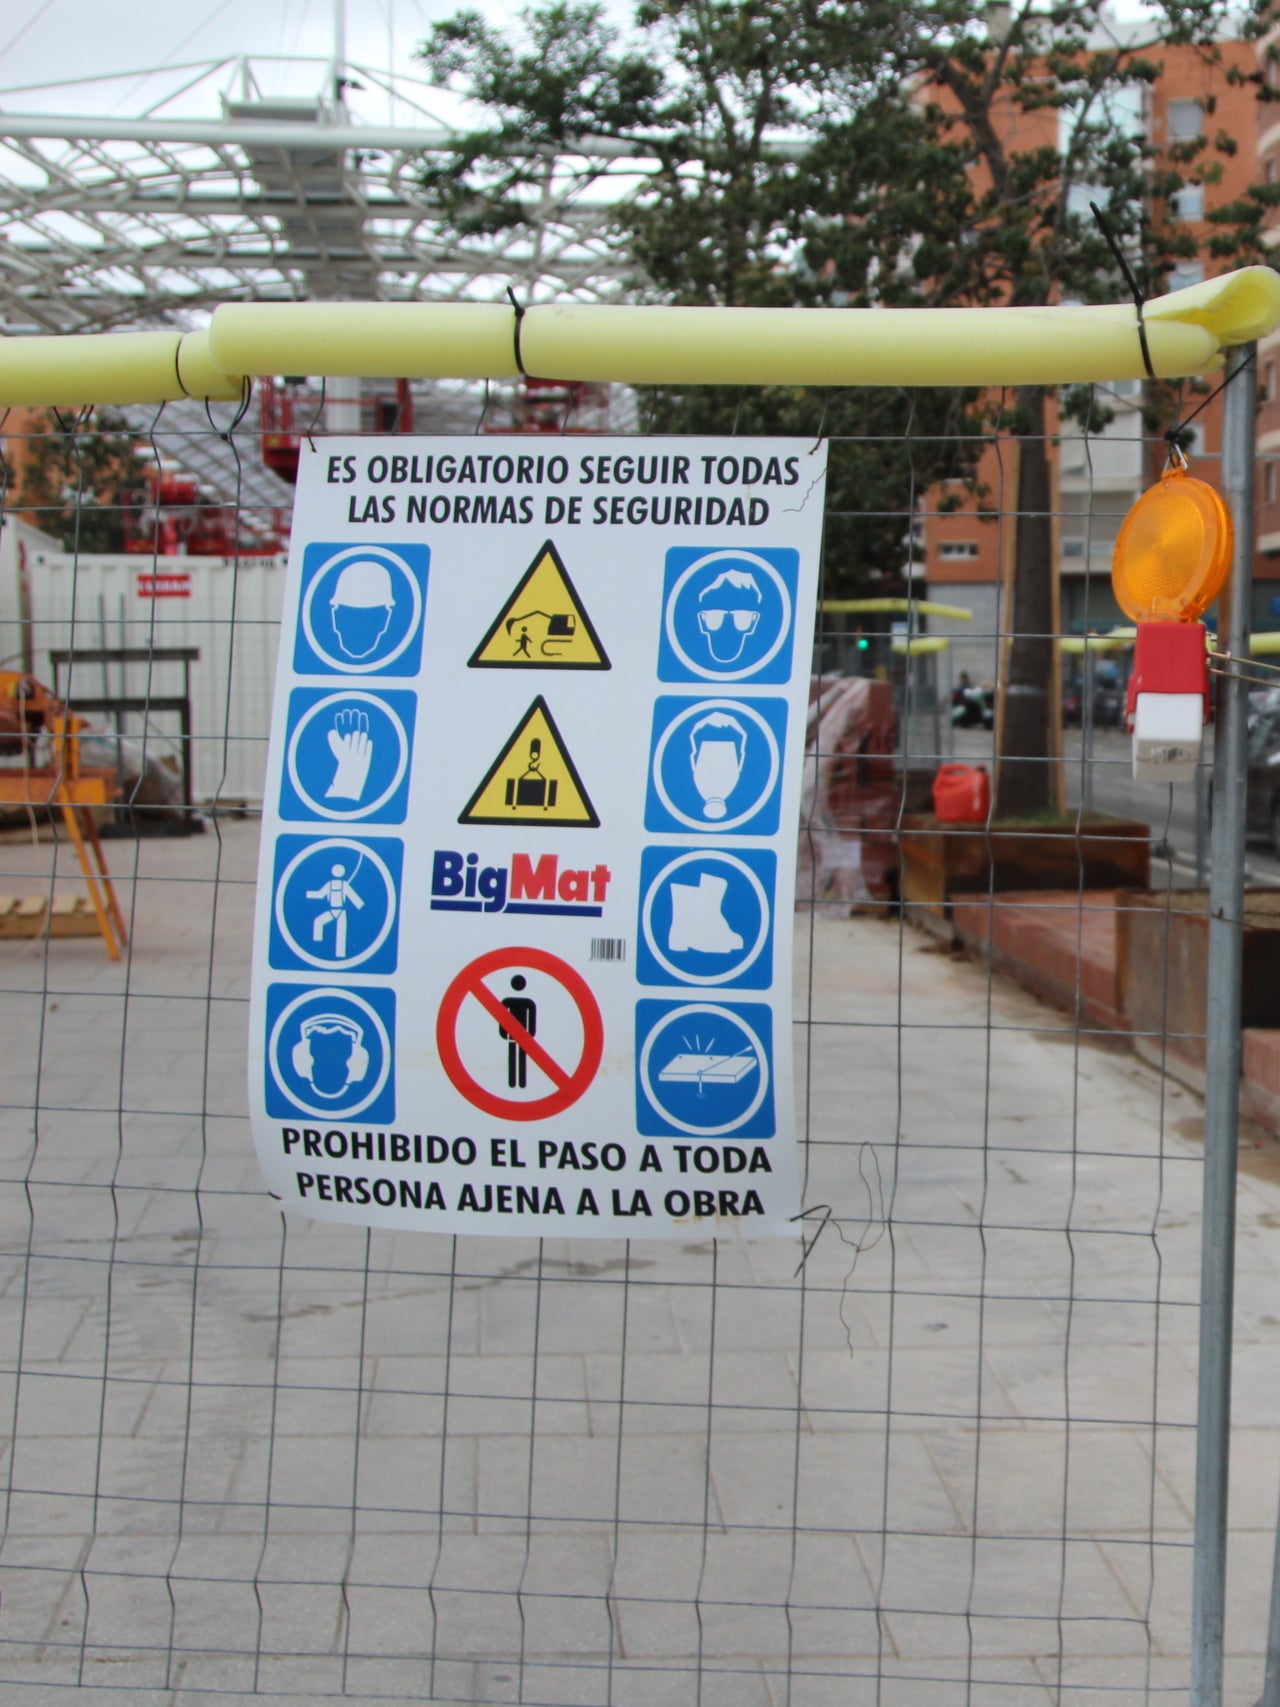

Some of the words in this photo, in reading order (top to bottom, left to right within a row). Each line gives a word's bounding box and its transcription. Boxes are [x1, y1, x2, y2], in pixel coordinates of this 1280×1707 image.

[328, 456, 356, 483] ES
[368, 456, 568, 483] OBLIGATORIO
[580, 456, 689, 483] SEGUIR
[702, 456, 798, 485] TODAS
[349, 495, 395, 523] LAS
[407, 496, 533, 523] NORMAS
[545, 497, 582, 524] DE
[593, 497, 769, 525] SEGURIDAD
[431, 851, 611, 912] BigMat
[283, 1128, 476, 1165] PROHIBIDO
[491, 1139, 526, 1167] EL
[539, 1141, 626, 1171] PASO
[640, 1145, 662, 1172] A
[673, 1146, 772, 1173] TODA
[297, 1172, 446, 1210] PERSONA
[458, 1184, 565, 1214] AJENA
[577, 1188, 599, 1215] A
[612, 1189, 652, 1216] LA
[664, 1190, 764, 1217] OBRA
